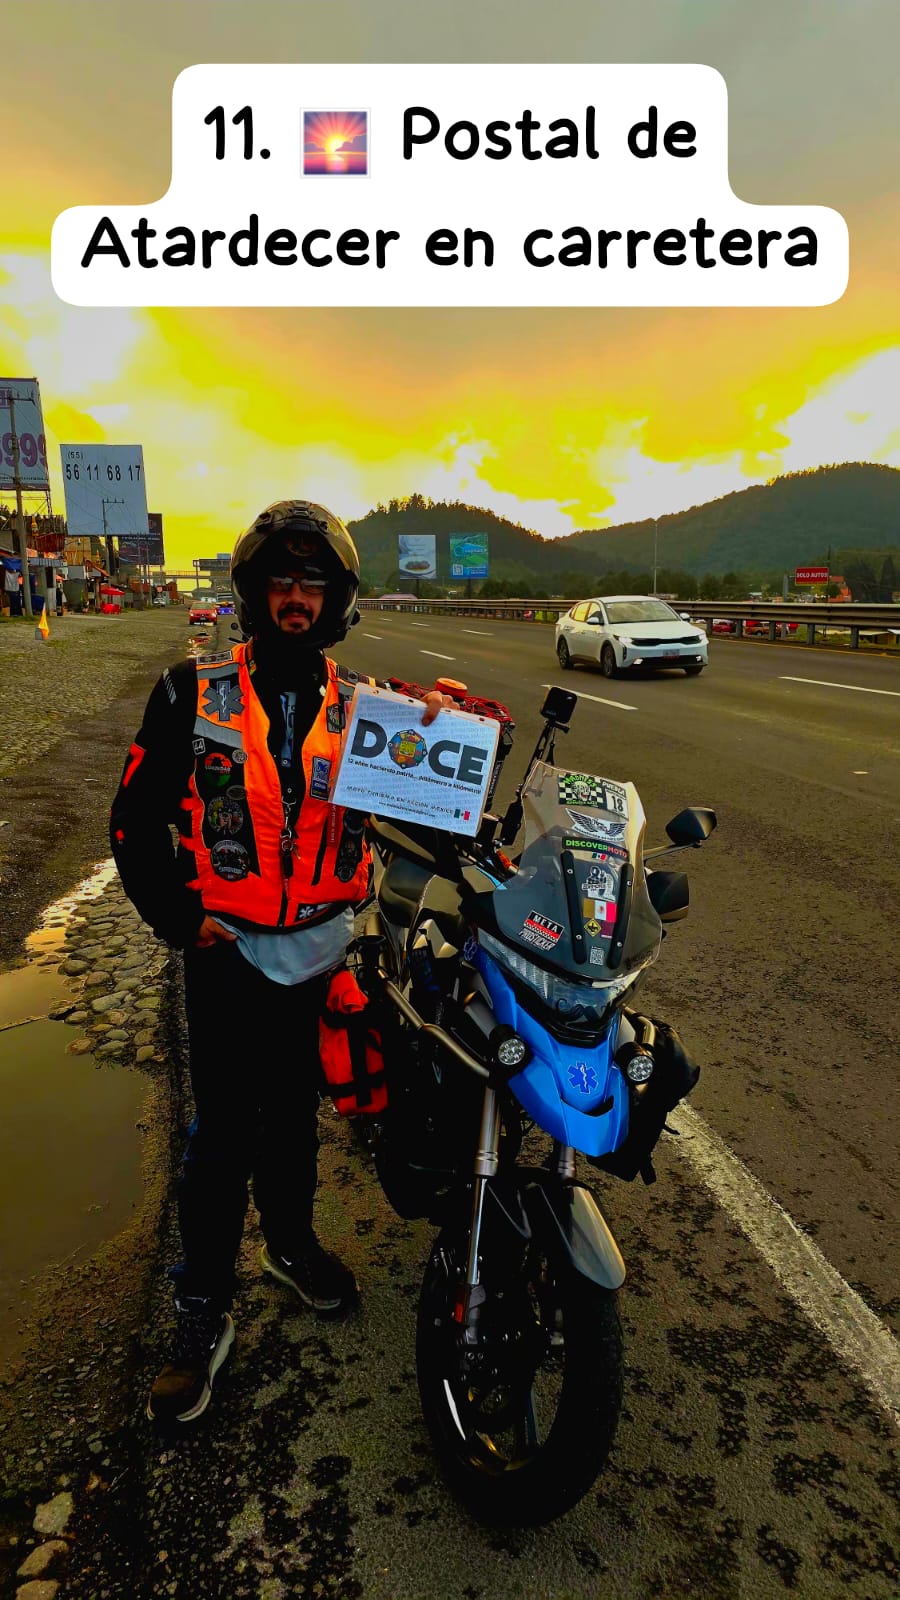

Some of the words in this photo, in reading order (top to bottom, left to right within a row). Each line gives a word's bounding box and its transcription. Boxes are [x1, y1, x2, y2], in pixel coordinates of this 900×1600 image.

[67, 450, 84, 460] (55)
[65, 463, 80, 481] 56
[86, 464, 99, 481] 11
[106, 465, 122, 482] 68
[128, 465, 141, 481] 17
[611, 795, 624, 813] 18
[532, 914, 559, 933] META
